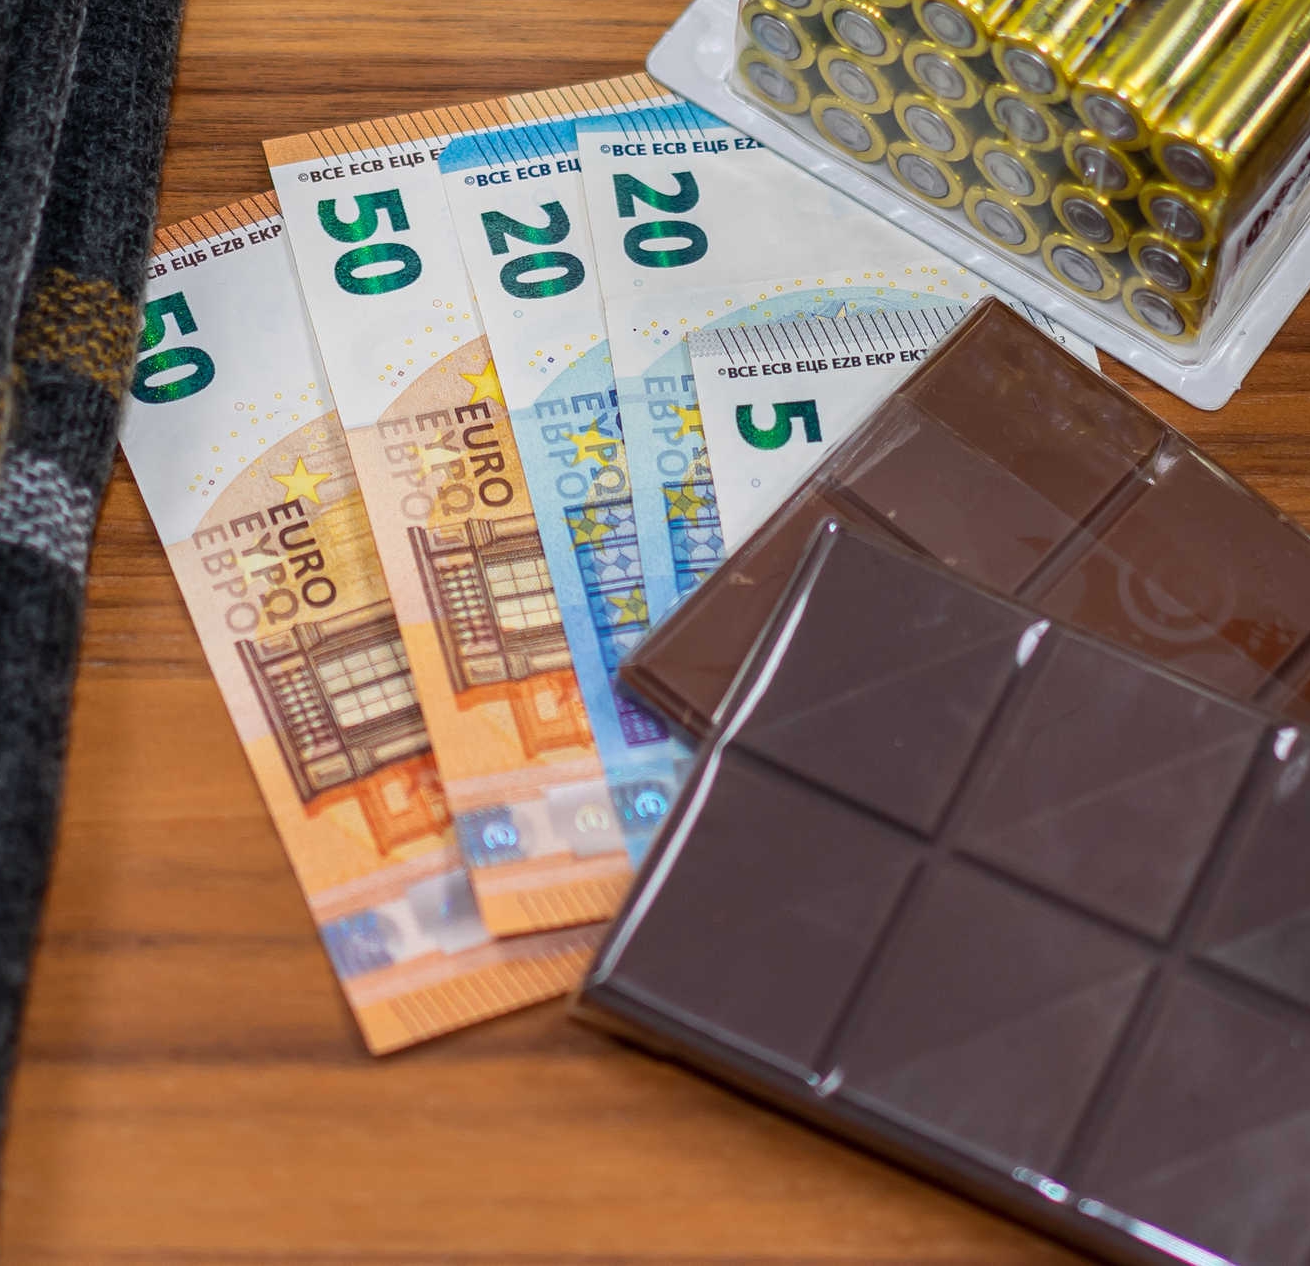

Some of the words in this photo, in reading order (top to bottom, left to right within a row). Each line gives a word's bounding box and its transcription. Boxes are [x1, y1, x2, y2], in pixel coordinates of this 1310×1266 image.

[349, 159, 384, 176] ECB
[516, 163, 551, 180] ECB
[556, 158, 582, 173] ЕЦ
[652, 142, 687, 155] ECB
[145, 263, 168, 280] CB
[210, 237, 245, 257] EZB
[248, 224, 282, 246] EKP
[317, 188, 422, 295] 50
[480, 201, 585, 299] 20
[612, 171, 709, 268] 20
[129, 290, 216, 404] 50
[762, 362, 792, 376] ECB
[832, 356, 862, 370] EZB
[865, 352, 895, 366] EKP
[454, 401, 514, 507] EURO
[736, 399, 822, 450] 5
[267, 499, 337, 608] EURO
